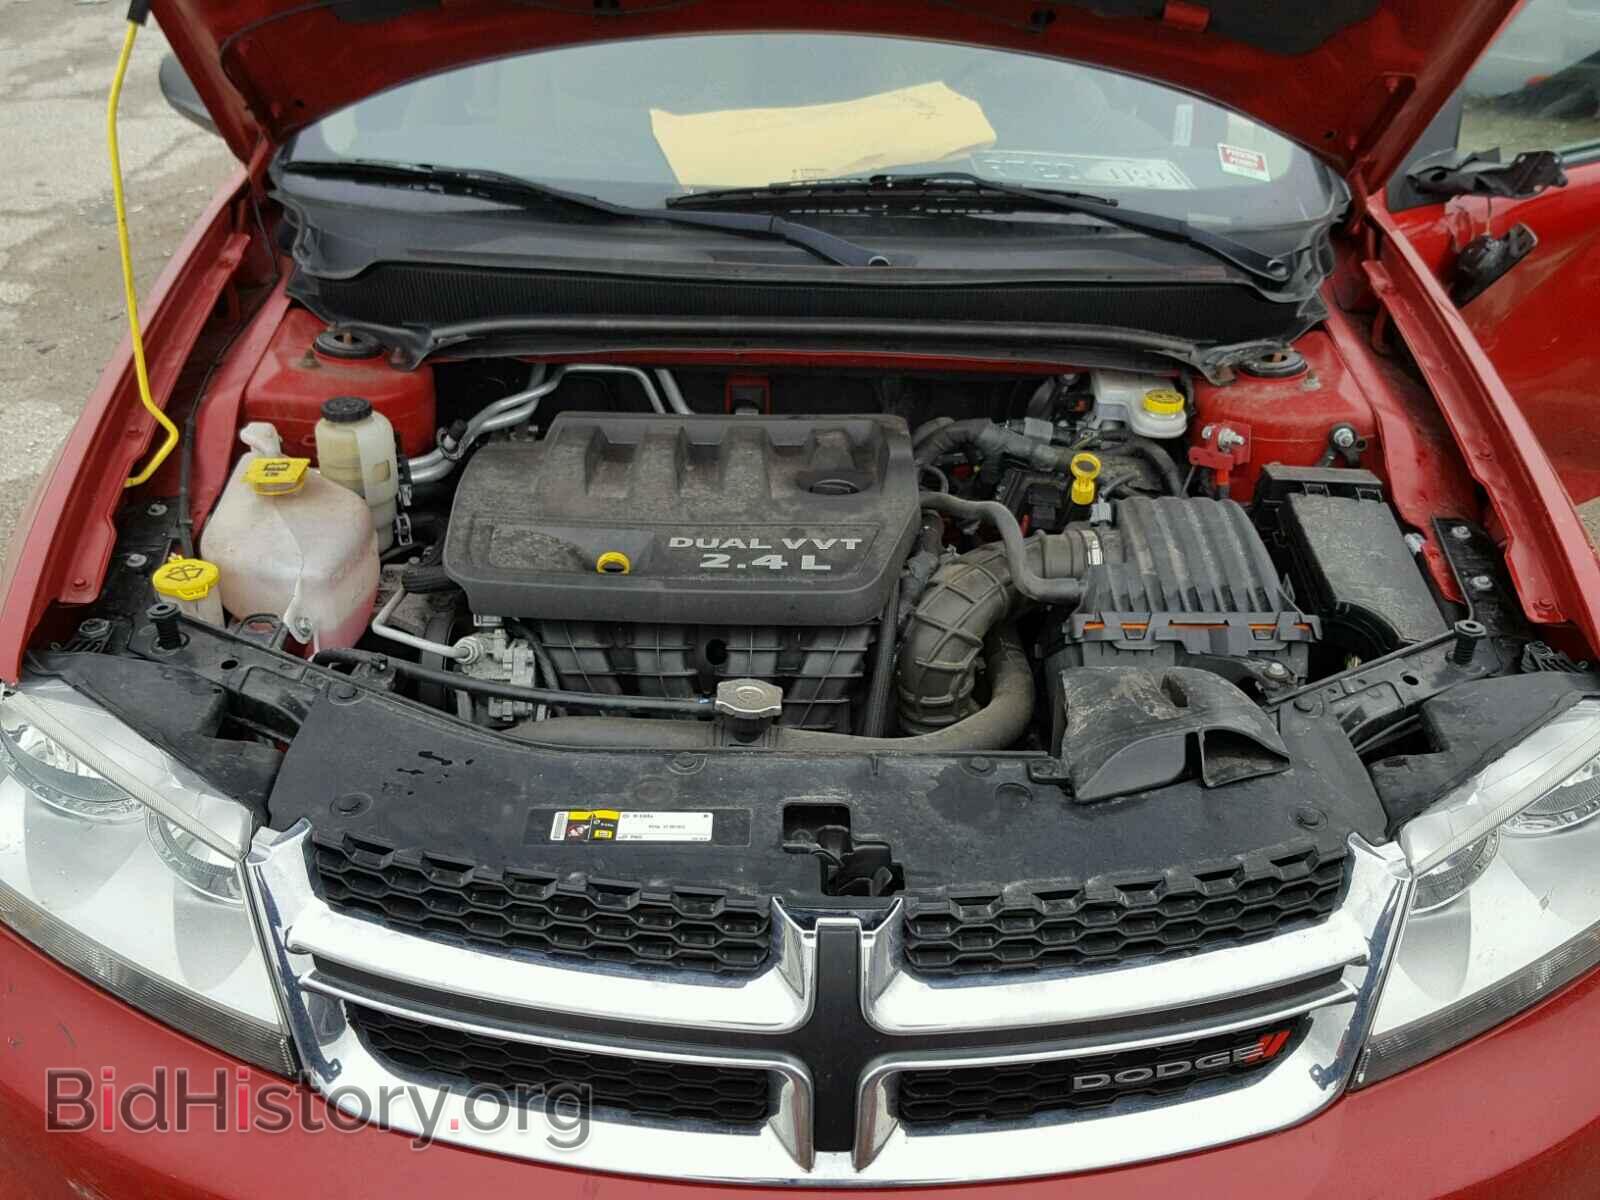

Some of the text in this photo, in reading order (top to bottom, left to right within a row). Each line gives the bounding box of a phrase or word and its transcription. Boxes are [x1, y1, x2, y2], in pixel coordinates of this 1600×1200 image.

[668, 537, 863, 550] DUAL VVT
[699, 553, 831, 570] 2.4 L
[1073, 1042, 1265, 1090] DODGE
